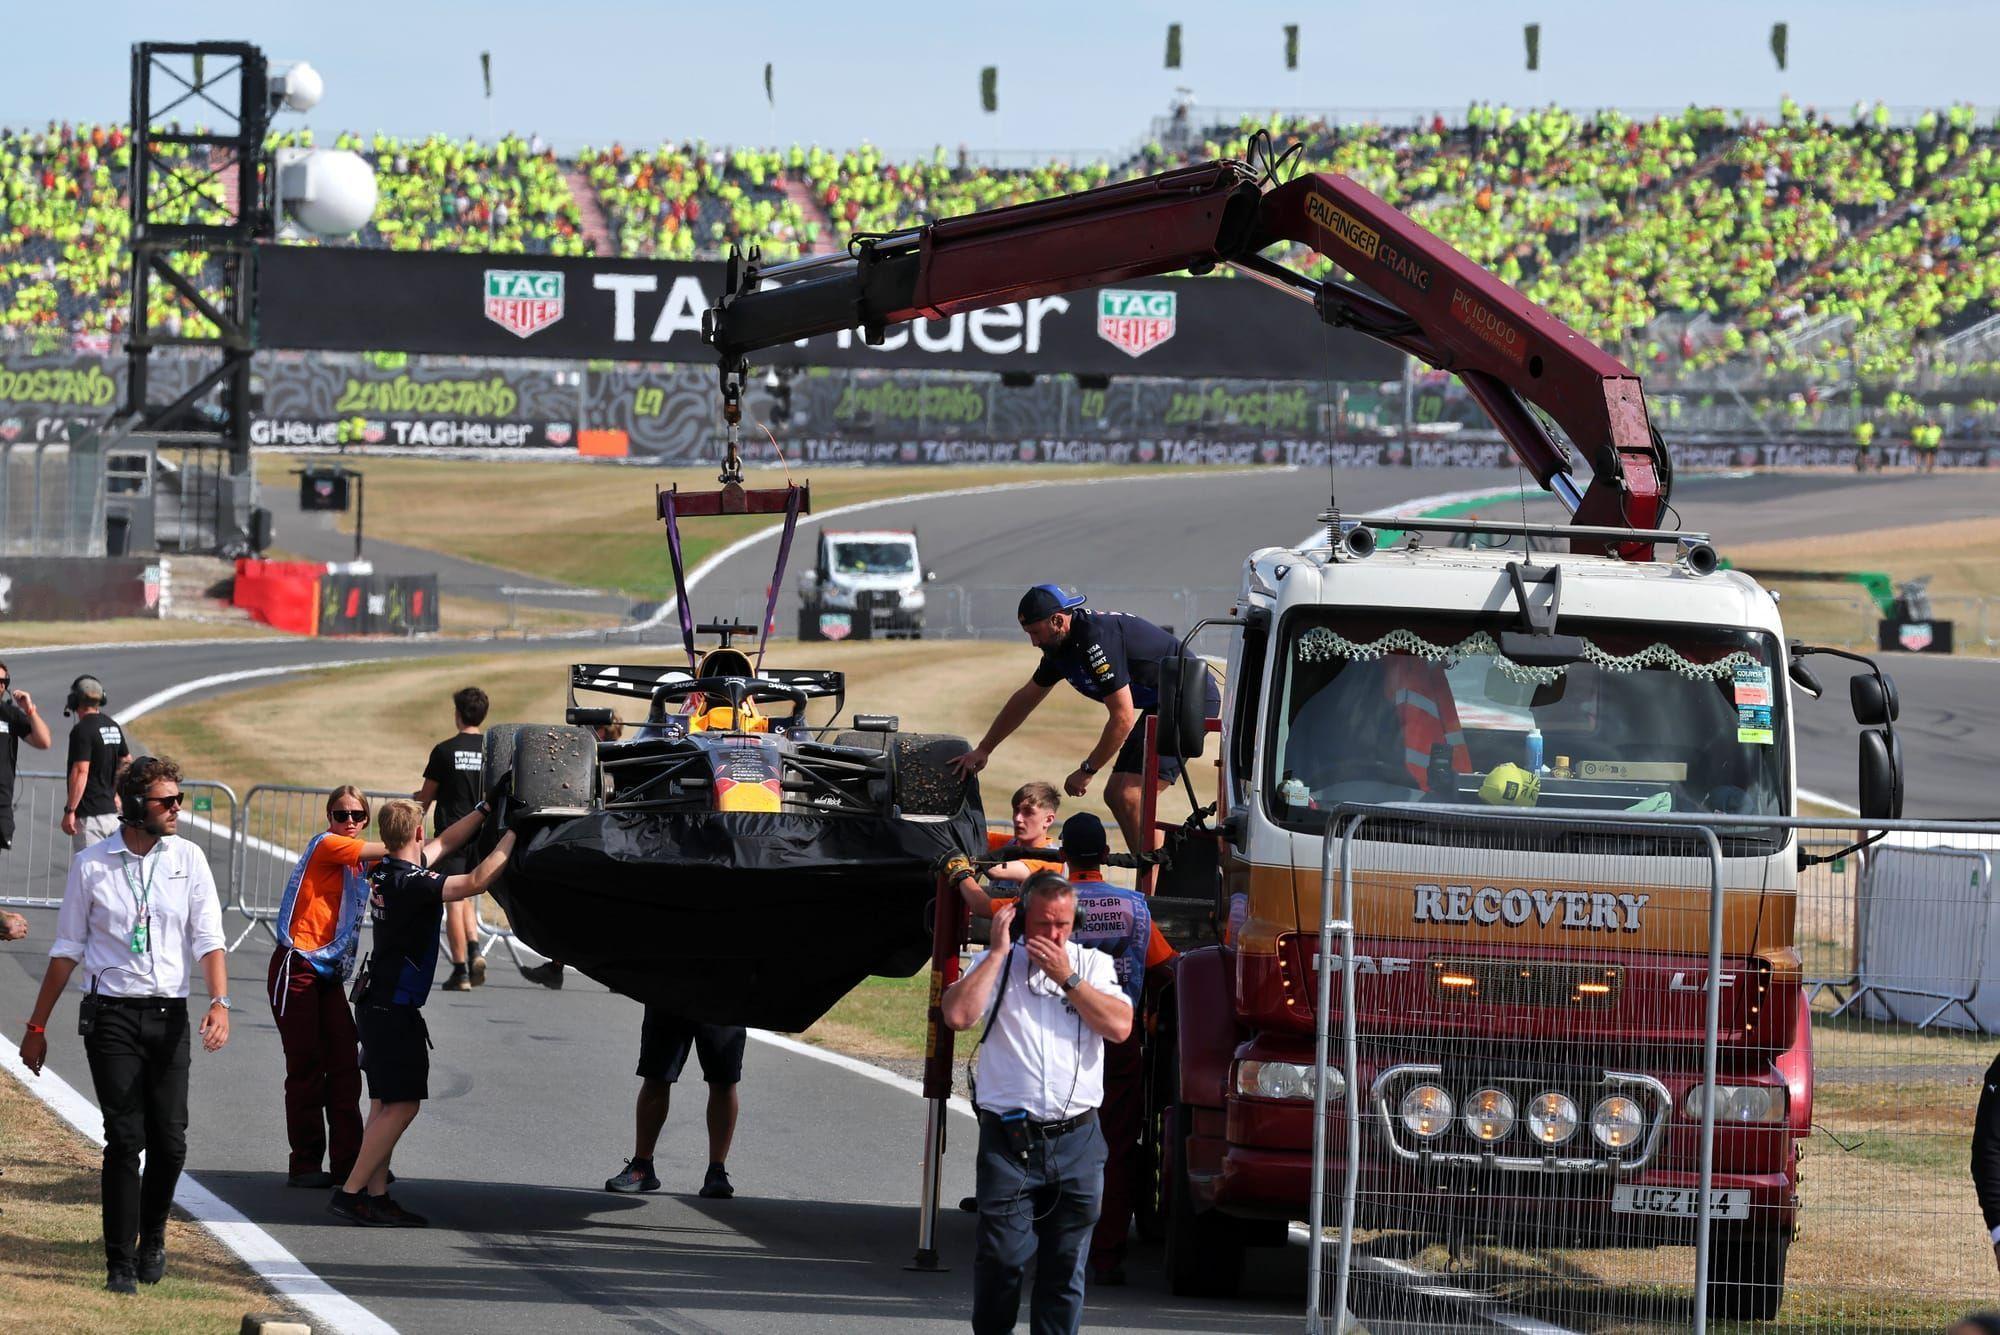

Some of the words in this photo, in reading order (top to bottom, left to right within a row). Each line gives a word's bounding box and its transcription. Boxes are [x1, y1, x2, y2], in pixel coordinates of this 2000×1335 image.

[1308, 197, 1376, 256] PALFINGER
[493, 275, 557, 297] TAG
[489, 300, 560, 332] HEUER
[593, 273, 1070, 355] TAuer
[1106, 295, 1169, 316] TAG
[1453, 288, 1472, 313] PK
[1473, 304, 1516, 344] 10000
[1103, 319, 1172, 352] HEUER
[0, 364, 115, 406] DOSTAND
[250, 420, 339, 446] GHeue
[1087, 911, 1122, 923] COVERY
[1414, 883, 1650, 933] RECOVERY
[1082, 921, 1126, 933] RSONNEL
[1311, 953, 1411, 975] DAF
[1632, 1189, 1682, 1213] UGZ
